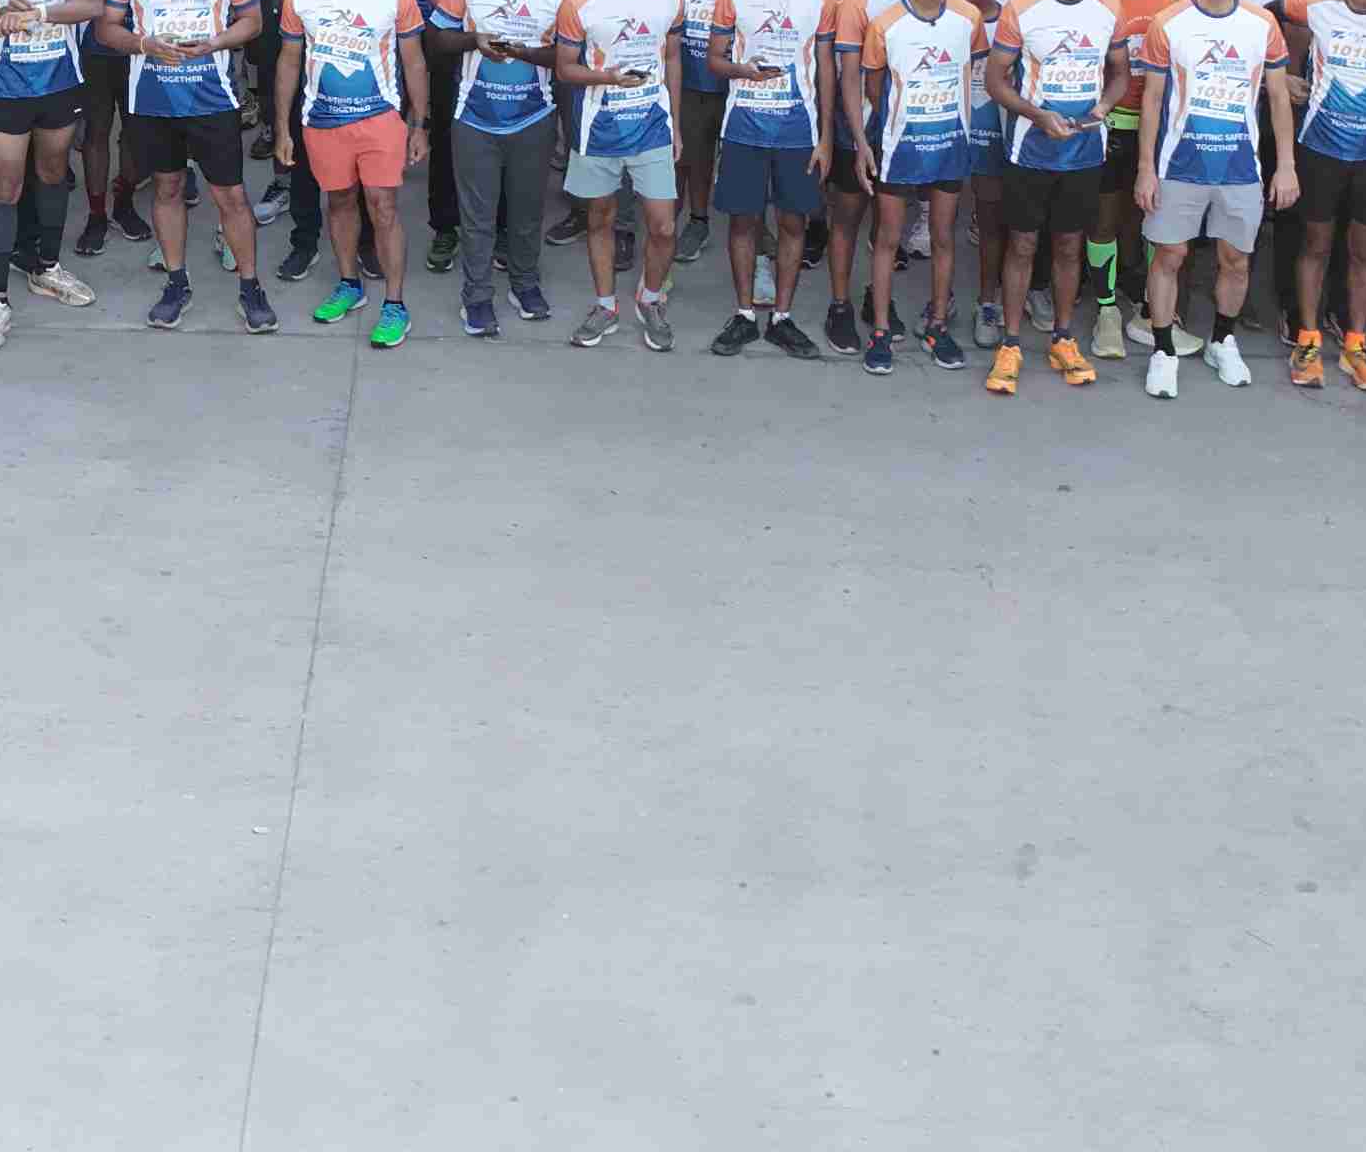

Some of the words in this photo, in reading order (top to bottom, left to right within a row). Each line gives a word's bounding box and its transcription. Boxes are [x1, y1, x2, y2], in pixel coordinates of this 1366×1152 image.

[156, 74, 203, 83] TOGETHER
[486, 92, 528, 100] TOGETHER
[1195, 143, 1239, 152] TOGETHER
